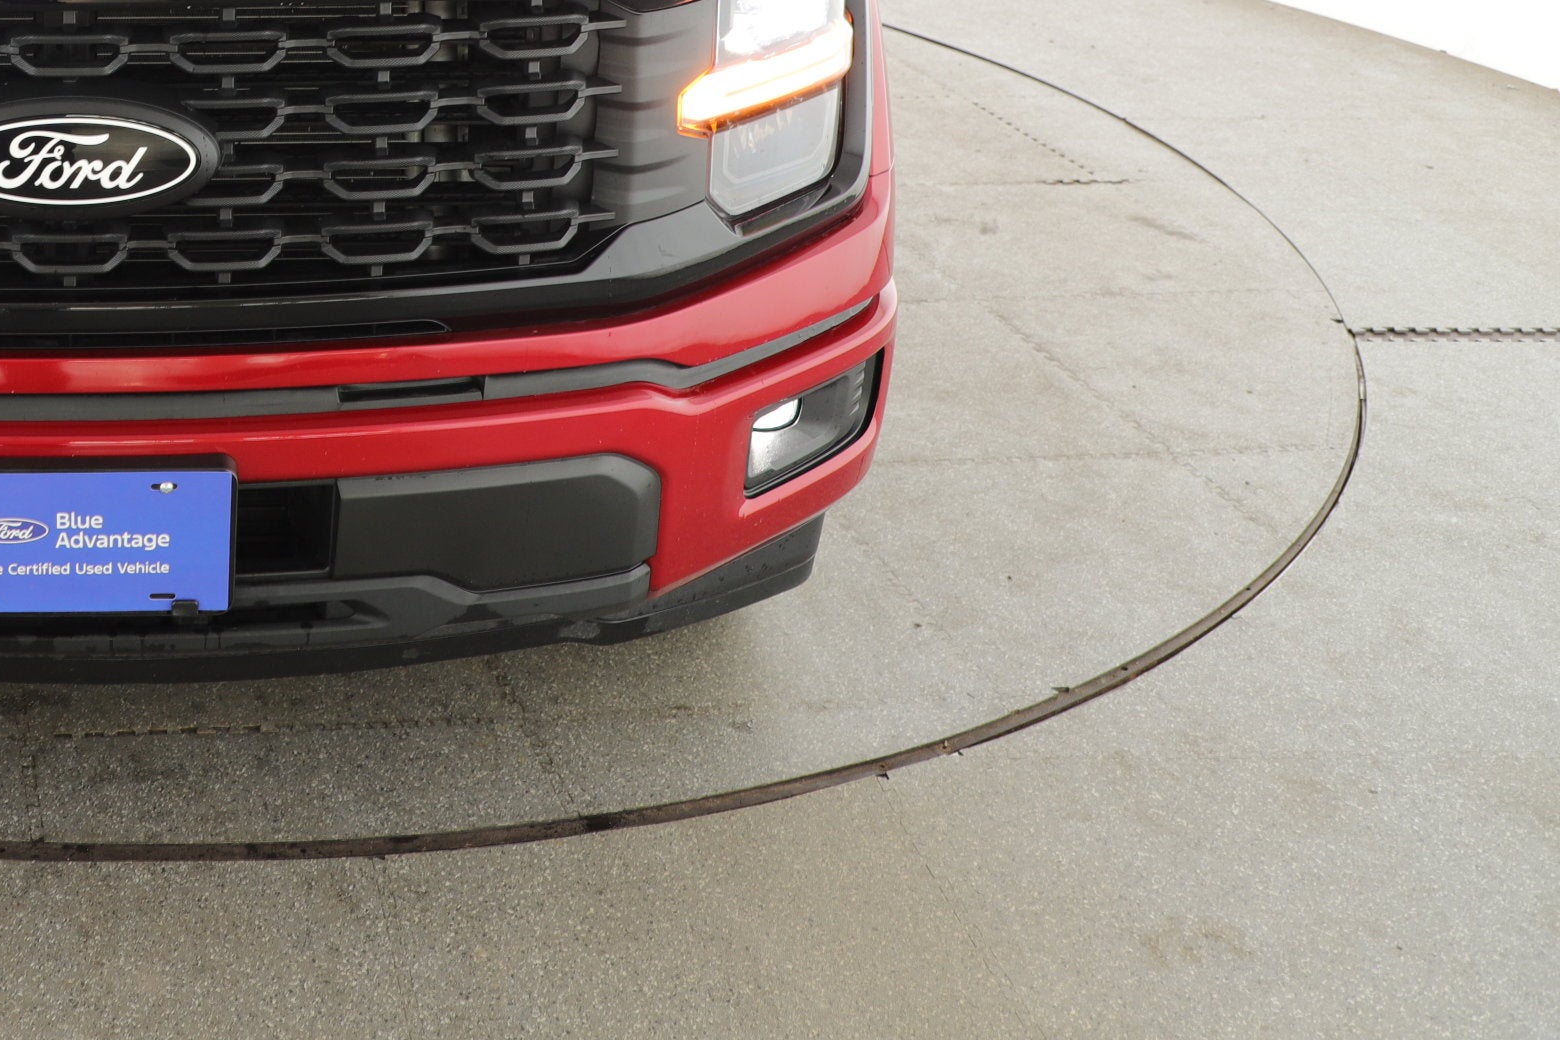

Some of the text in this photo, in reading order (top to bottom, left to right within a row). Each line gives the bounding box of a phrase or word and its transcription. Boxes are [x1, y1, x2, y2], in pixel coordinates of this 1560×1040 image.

[56, 512, 103, 530] Blue
[55, 531, 170, 551] Advantage
[8, 562, 70, 576] Certified
[75, 562, 113, 575] Used
[117, 561, 170, 574] Vehicle
